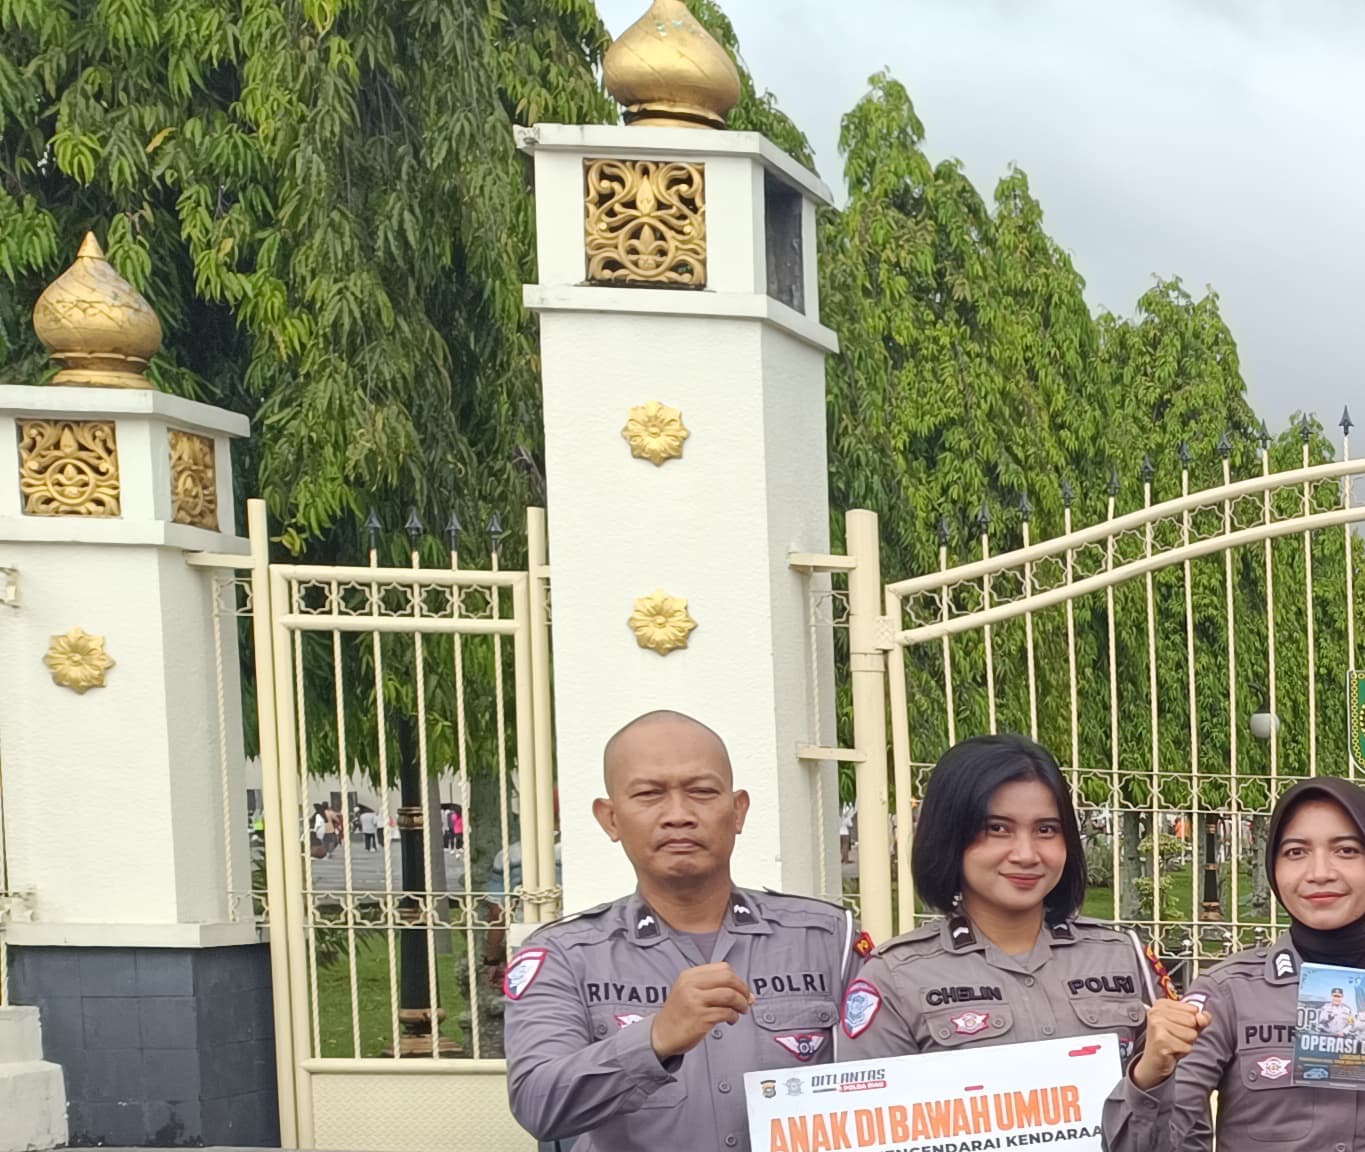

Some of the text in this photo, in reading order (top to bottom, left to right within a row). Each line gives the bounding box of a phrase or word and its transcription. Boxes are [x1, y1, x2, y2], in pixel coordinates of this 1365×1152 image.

[588, 983, 667, 1004] RIYADI
[754, 973, 827, 995] POLRI
[1067, 975, 1136, 995] POLRI
[926, 985, 1003, 1007] CHELIN
[1301, 1034, 1359, 1055] OPERASI
[811, 1068, 886, 1087] DITLANTAS
[854, 1107, 882, 1148] DI
[889, 1097, 991, 1143] BAWAH
[994, 1085, 1082, 1131] UMUR
